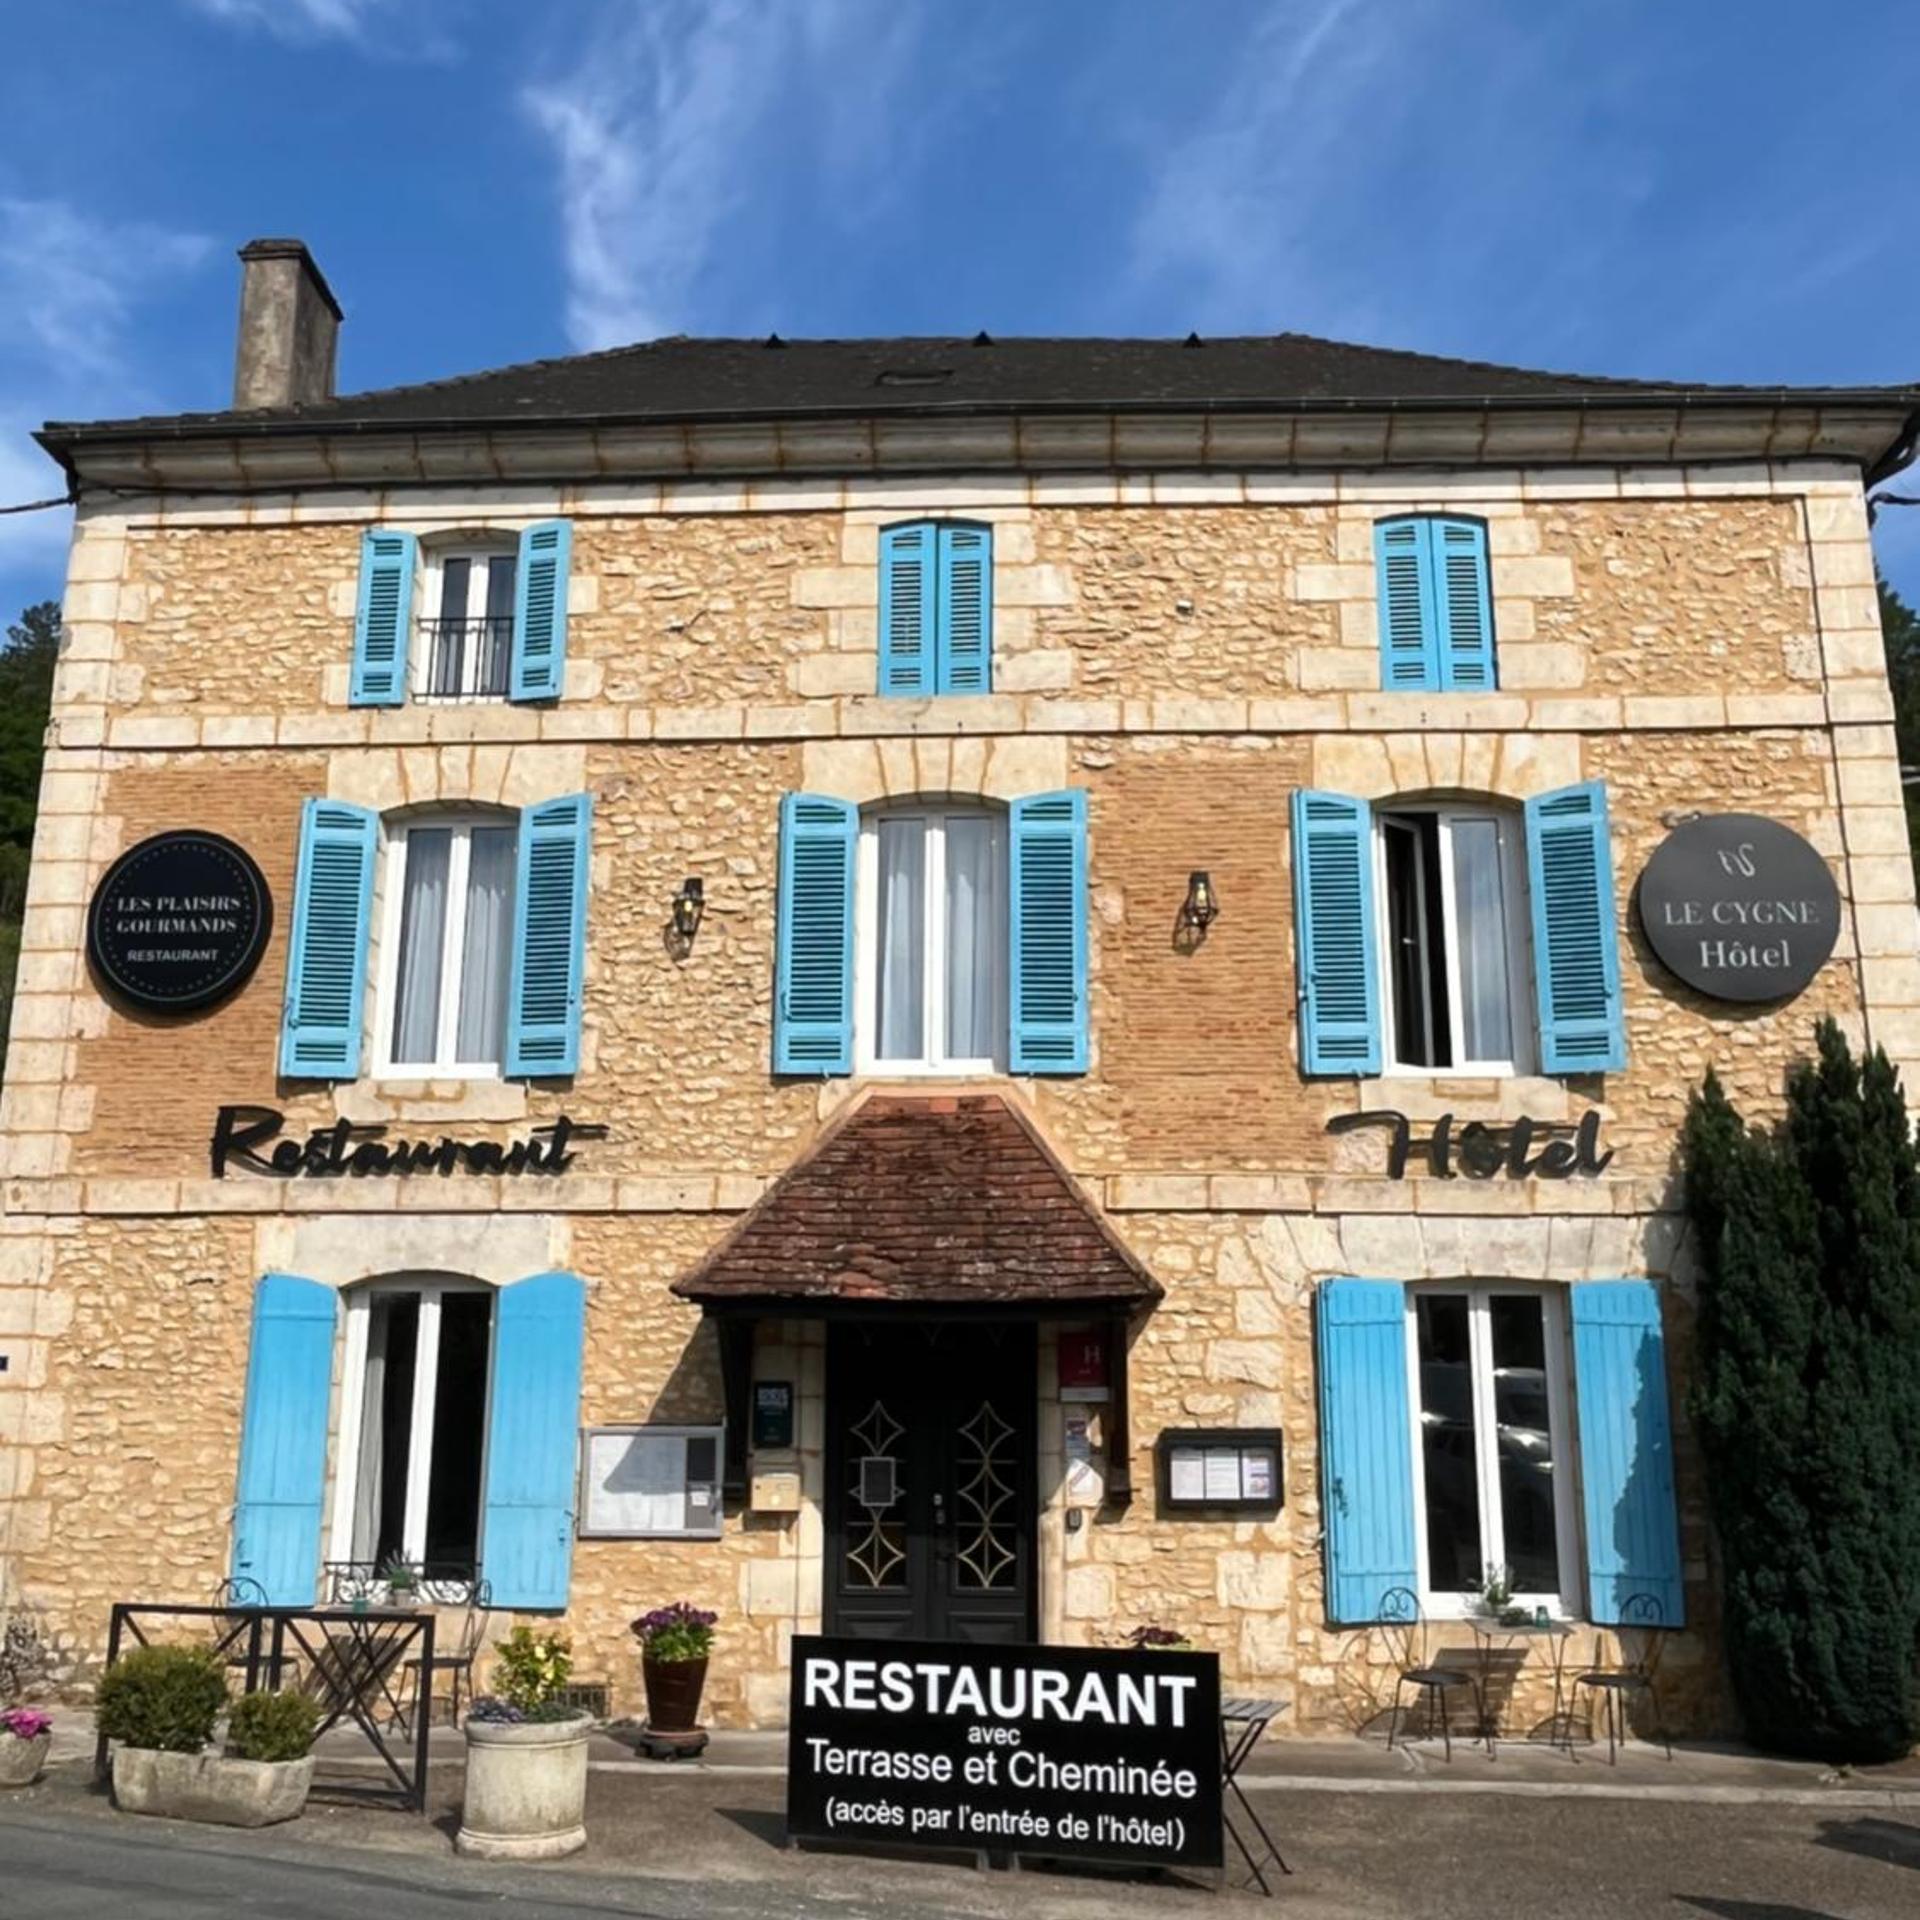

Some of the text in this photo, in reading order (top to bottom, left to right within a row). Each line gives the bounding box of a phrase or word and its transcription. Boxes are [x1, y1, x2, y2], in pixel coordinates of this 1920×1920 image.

[116, 896, 241, 912] LES PLAISIRS
[1664, 902, 1819, 925] LE CYGNE
[116, 917, 238, 934] GOURMANDS
[127, 949, 219, 962] RESTAURANT
[1700, 939, 1791, 968] Hôtel
[209, 1104, 611, 1178] Restaurant
[803, 1657, 1197, 1728] RESTAURANT
[967, 1724, 1021, 1746] avec
[805, 1738, 1197, 1798] Terrasse et Cheminée
[825, 1796, 1186, 1850] (accès par l'entrée de l'hôtel)
